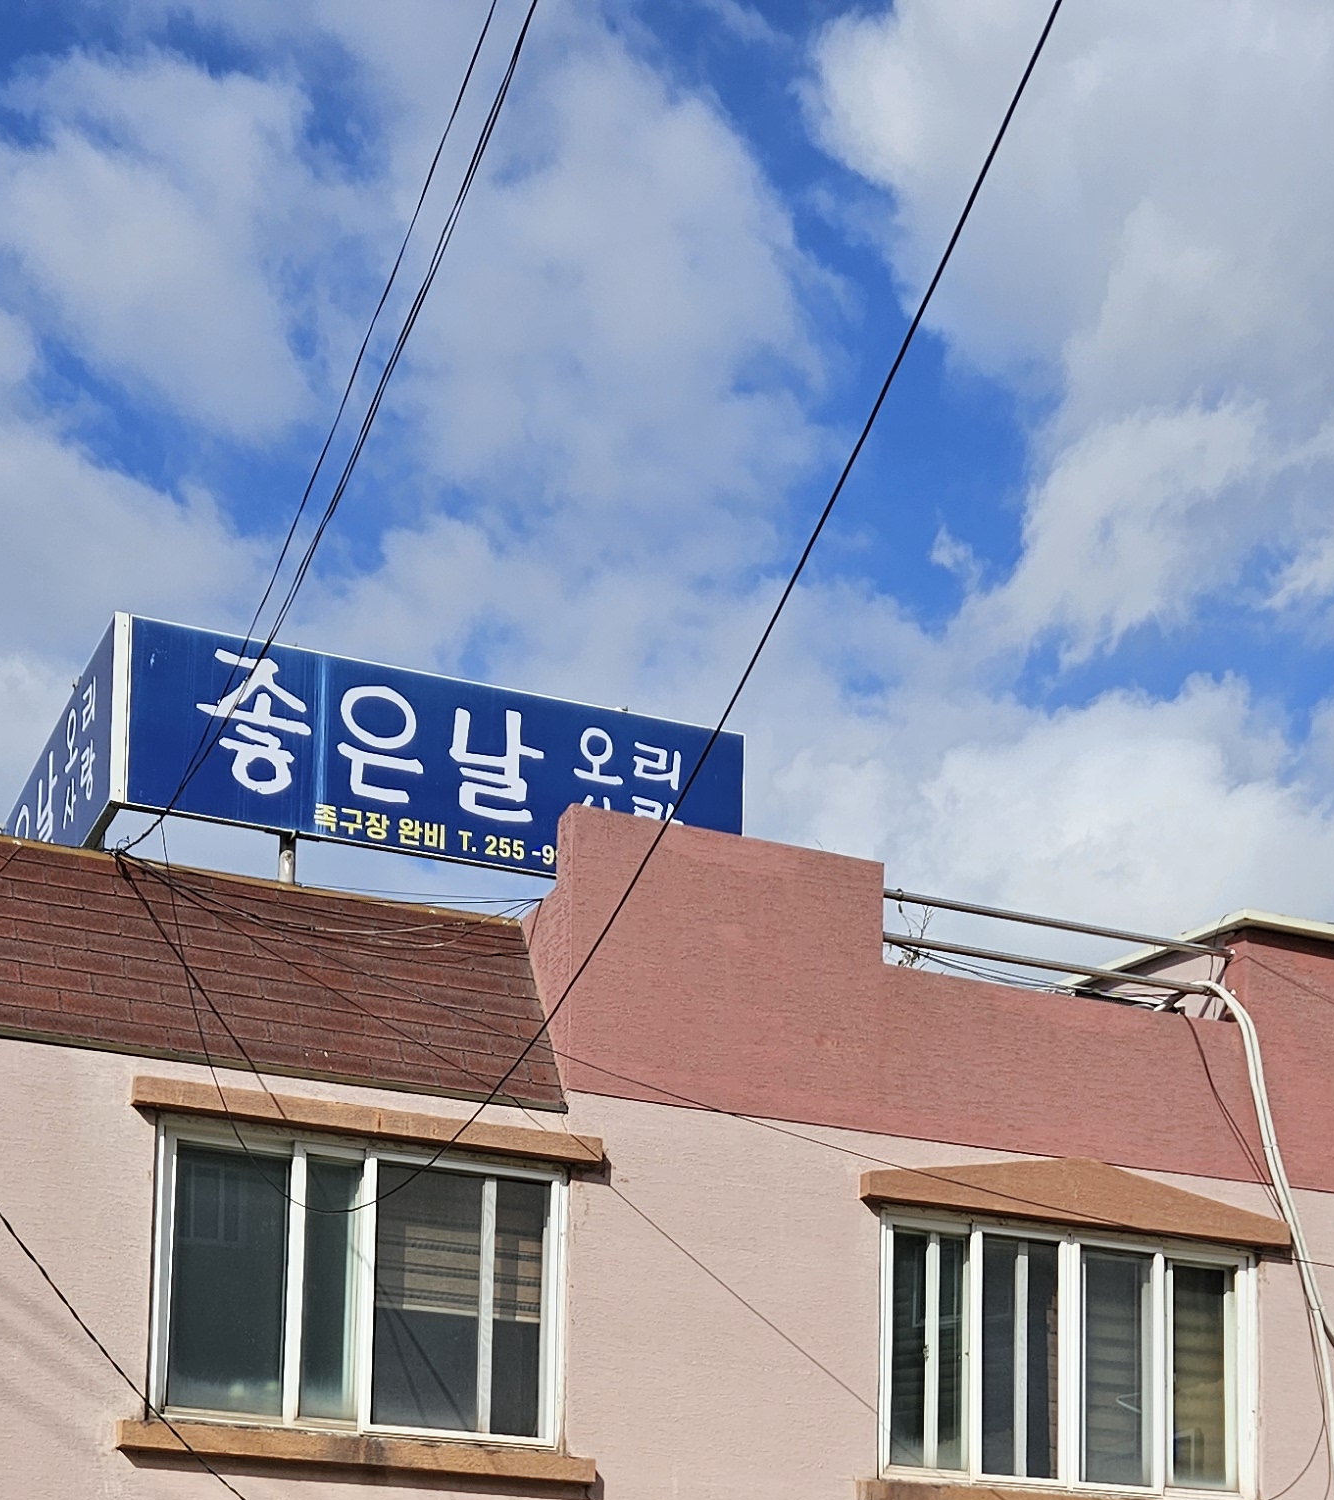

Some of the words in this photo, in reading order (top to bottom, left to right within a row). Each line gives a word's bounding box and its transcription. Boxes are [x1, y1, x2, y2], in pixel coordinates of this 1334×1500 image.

[196, 647, 546, 824] 좋은날
[572, 726, 682, 791] 오리
[313, 801, 390, 841] 족구장
[397, 817, 446, 850] 완비
[457, 829, 477, 852] T.
[484, 835, 525, 861] 255
[531, 844, 558, 865] -9
